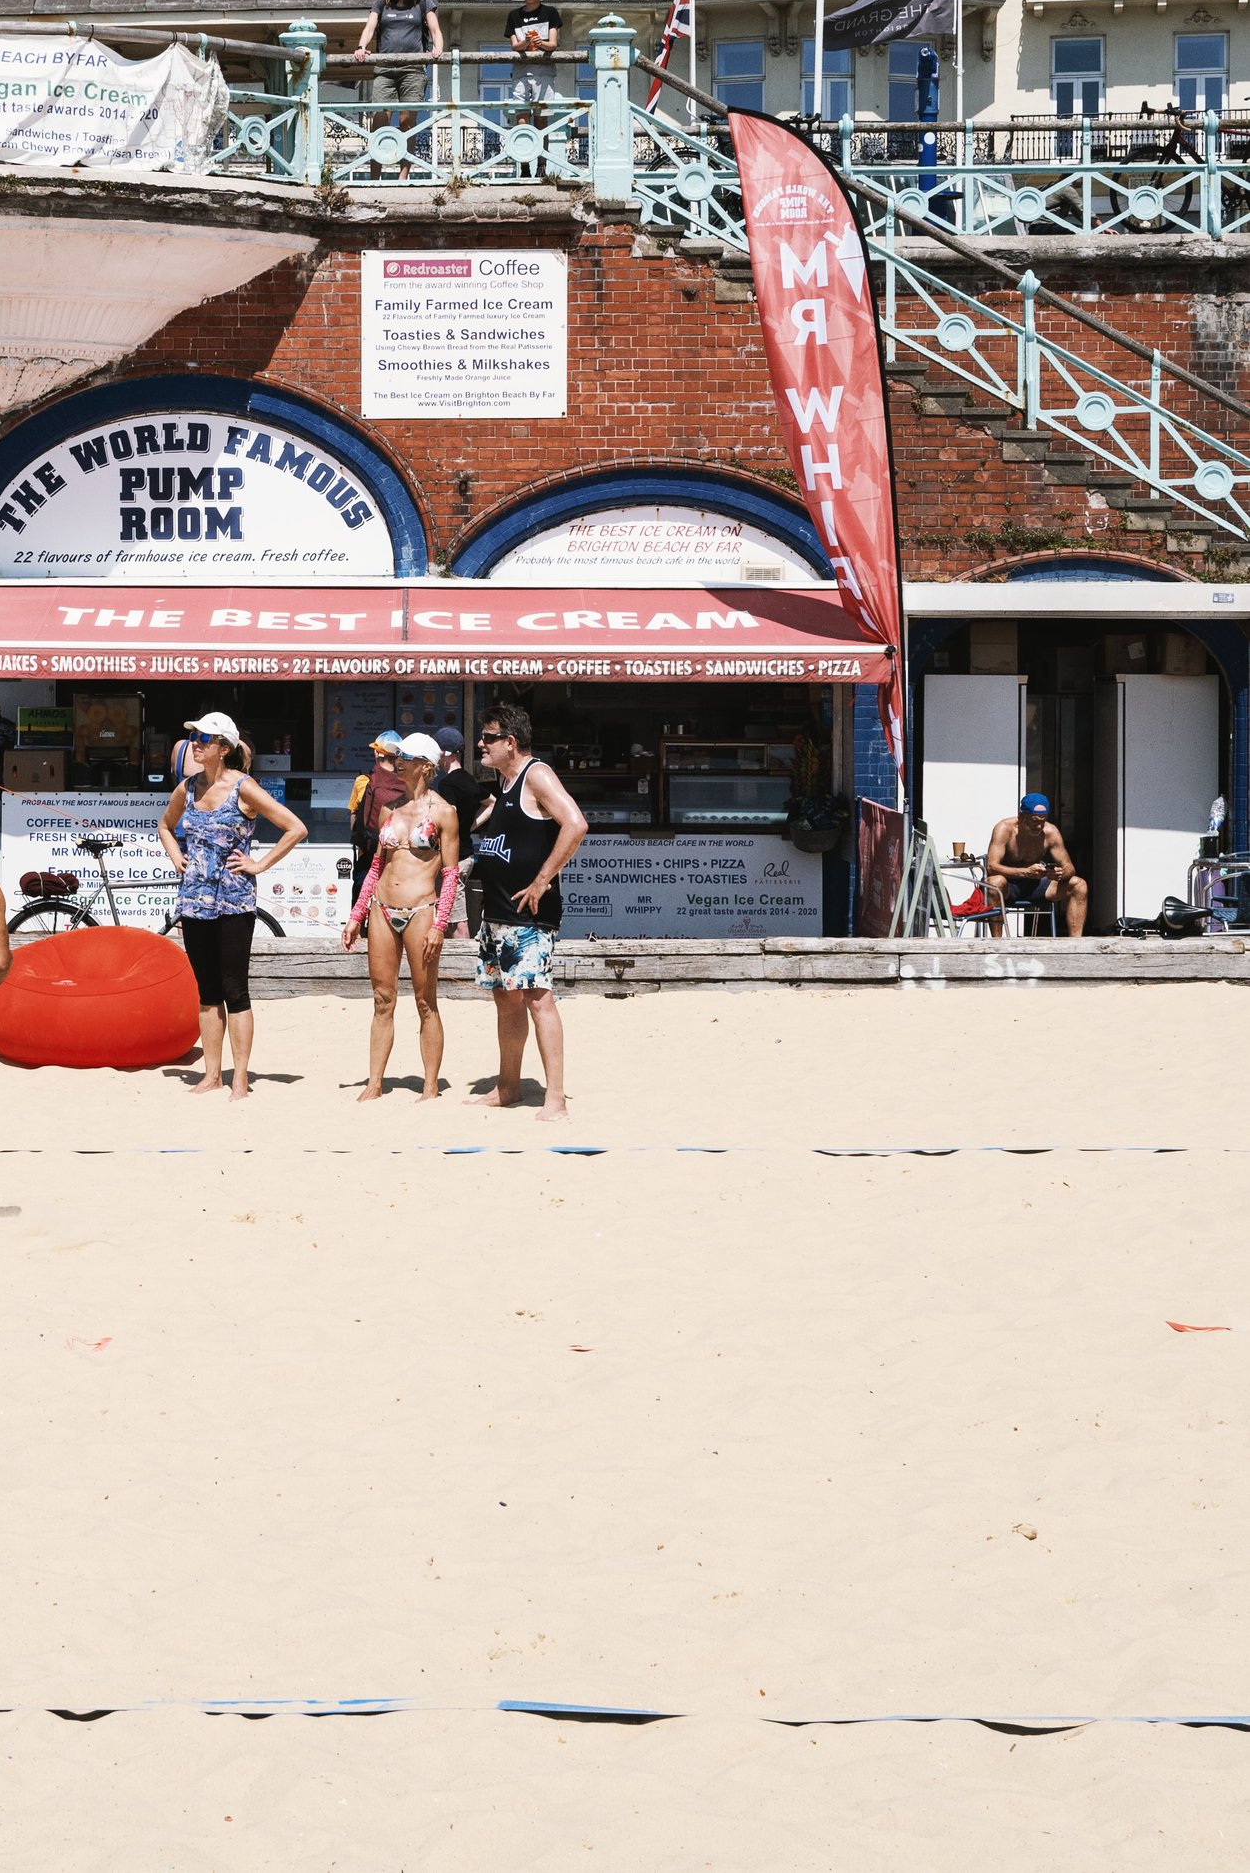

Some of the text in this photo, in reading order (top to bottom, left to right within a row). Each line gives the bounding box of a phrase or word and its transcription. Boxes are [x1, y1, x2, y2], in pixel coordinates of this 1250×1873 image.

[47, 81, 76, 99] Ice
[83, 82, 148, 106] Cream
[11, 102, 43, 114] taste
[47, 104, 94, 117] awards
[99, 107, 127, 121] 2014
[5, 126, 72, 142] Sandwiches
[22, 140, 60, 156] Chewy
[403, 259, 540, 276] Redroaster Coffee
[383, 280, 544, 290] From the award winning Coffee Shop
[375, 298, 553, 313] Family Farmed Ice Cream
[433, 313, 457, 321] Family
[383, 329, 545, 341] Toasties & Sandwiches
[378, 359, 550, 371] Smoothies & Milkshakes
[464, 391, 500, 400] Brighton
[418, 399, 511, 407] www.VisitBrighton.com
[68, 422, 211, 474] WORLD
[223, 425, 376, 532] FAMOUS
[119, 466, 244, 502] PUMP
[119, 506, 244, 542] ROOM
[568, 524, 742, 538] THE BEST ICE CREAM ON
[567, 540, 742, 553] BRIGHTON BEACH BY FAR
[13, 548, 298, 566] 22 flavours of farmhouse ice Fresh
[515, 555, 713, 567] Probably the most famous beach the
[56, 605, 761, 631] THE BEST ICE CREAM
[50, 654, 137, 674] SMOOTHIES
[149, 655, 200, 674] JUICES
[213, 656, 279, 674] PASTRIES
[292, 657, 310, 674] 22
[314, 657, 390, 675] FLAVOURS
[395, 658, 416, 675] OF
[420, 658, 461, 675] FARM
[465, 658, 488, 675] ICE
[492, 658, 543, 675] CREAM
[556, 659, 611, 676] COFFEE
[625, 659, 692, 676] TOASTIES
[705, 659, 804, 676] SANDWICHES
[817, 659, 862, 676] PIZZA
[26, 818, 158, 829] COFFEE SANDWICHES
[29, 832, 67, 842] FRESH
[589, 839, 612, 847] MOST
[613, 839, 646, 847] FAMOUS
[51, 848, 68, 857] MR
[580, 858, 652, 869] SMOOTHIES
[663, 858, 700, 869] CHIPS
[710, 859, 746, 869] PIZZA
[128, 867, 148, 879] Ice
[595, 873, 747, 884] SANDWICHES TOASTIES
[568, 892, 610, 904] Cream
[637, 896, 652, 904] MR
[686, 893, 804, 907] Vegan Ice Cream
[625, 906, 662, 914] WHIPPY
[689, 907, 767, 916] great taste awards
